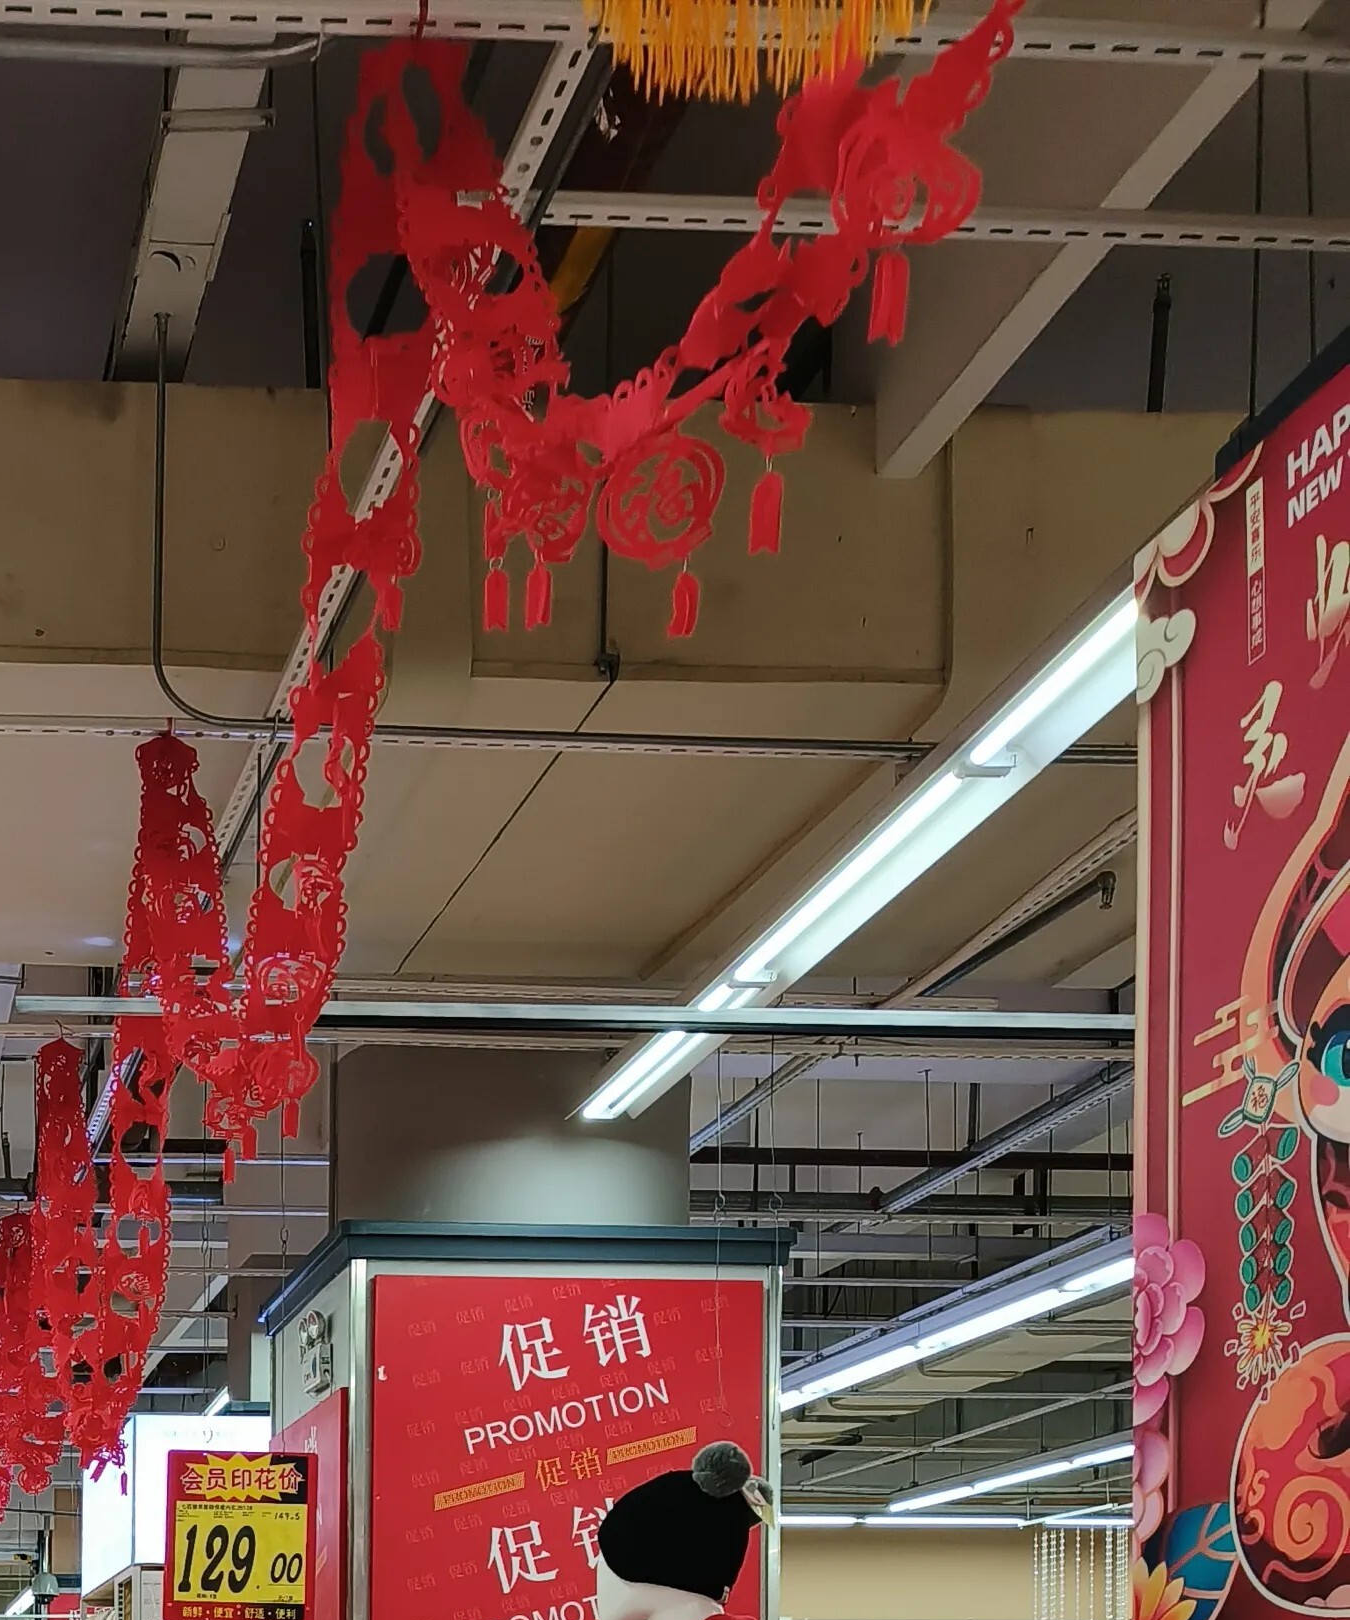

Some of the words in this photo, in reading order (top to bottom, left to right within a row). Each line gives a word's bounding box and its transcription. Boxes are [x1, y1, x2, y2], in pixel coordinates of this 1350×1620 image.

[1287, 455, 1343, 528] NEW
[1250, 579, 1262, 649] 心想事成
[499, 1294, 652, 1391] 促销
[464, 1378, 670, 1455] PROMOTION
[182, 1468, 302, 1491] 会员印花价
[535, 1447, 604, 1492] 促销
